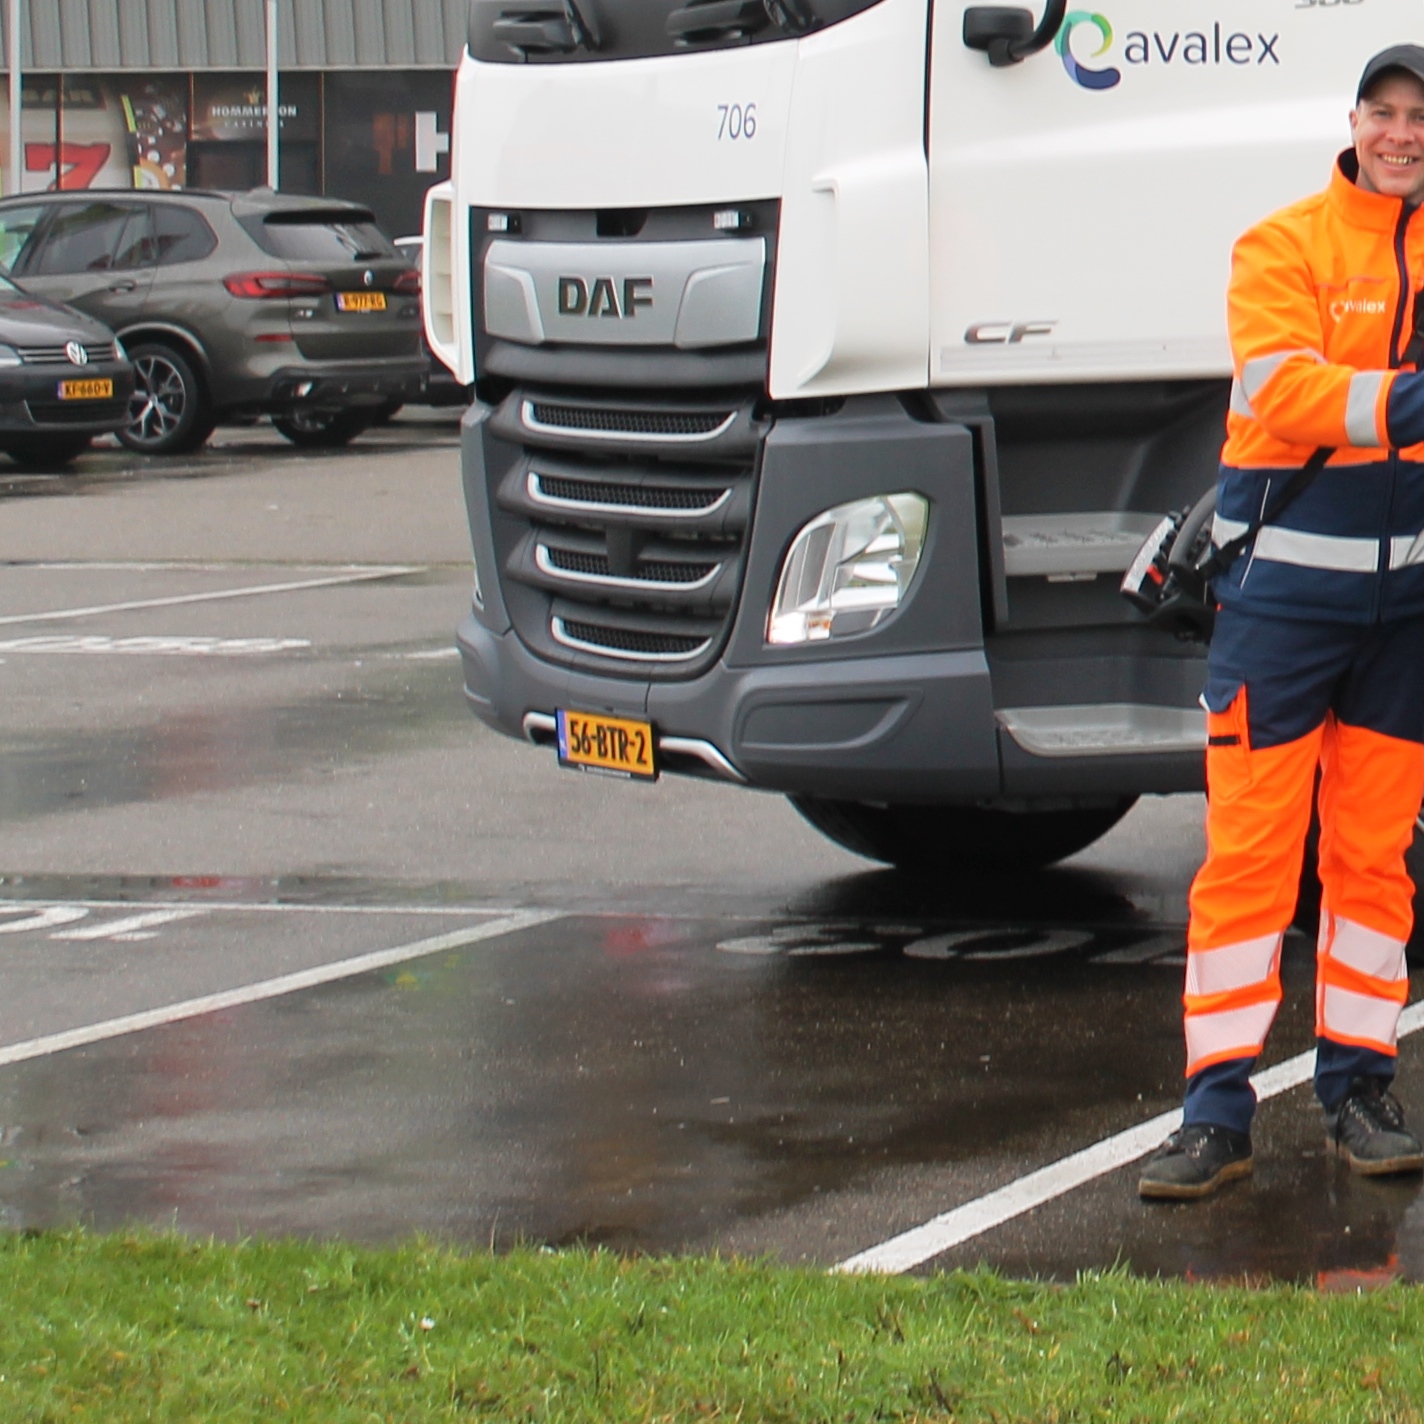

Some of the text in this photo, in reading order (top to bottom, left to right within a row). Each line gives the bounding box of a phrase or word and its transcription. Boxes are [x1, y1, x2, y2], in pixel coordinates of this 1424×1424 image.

[1124, 21, 1281, 66] avalex
[211, 104, 297, 117] HOMMEON
[716, 102, 759, 141] 706
[557, 276, 654, 318] DAF
[963, 318, 1061, 345] CF
[569, 718, 647, 765] 56-BTR-2
